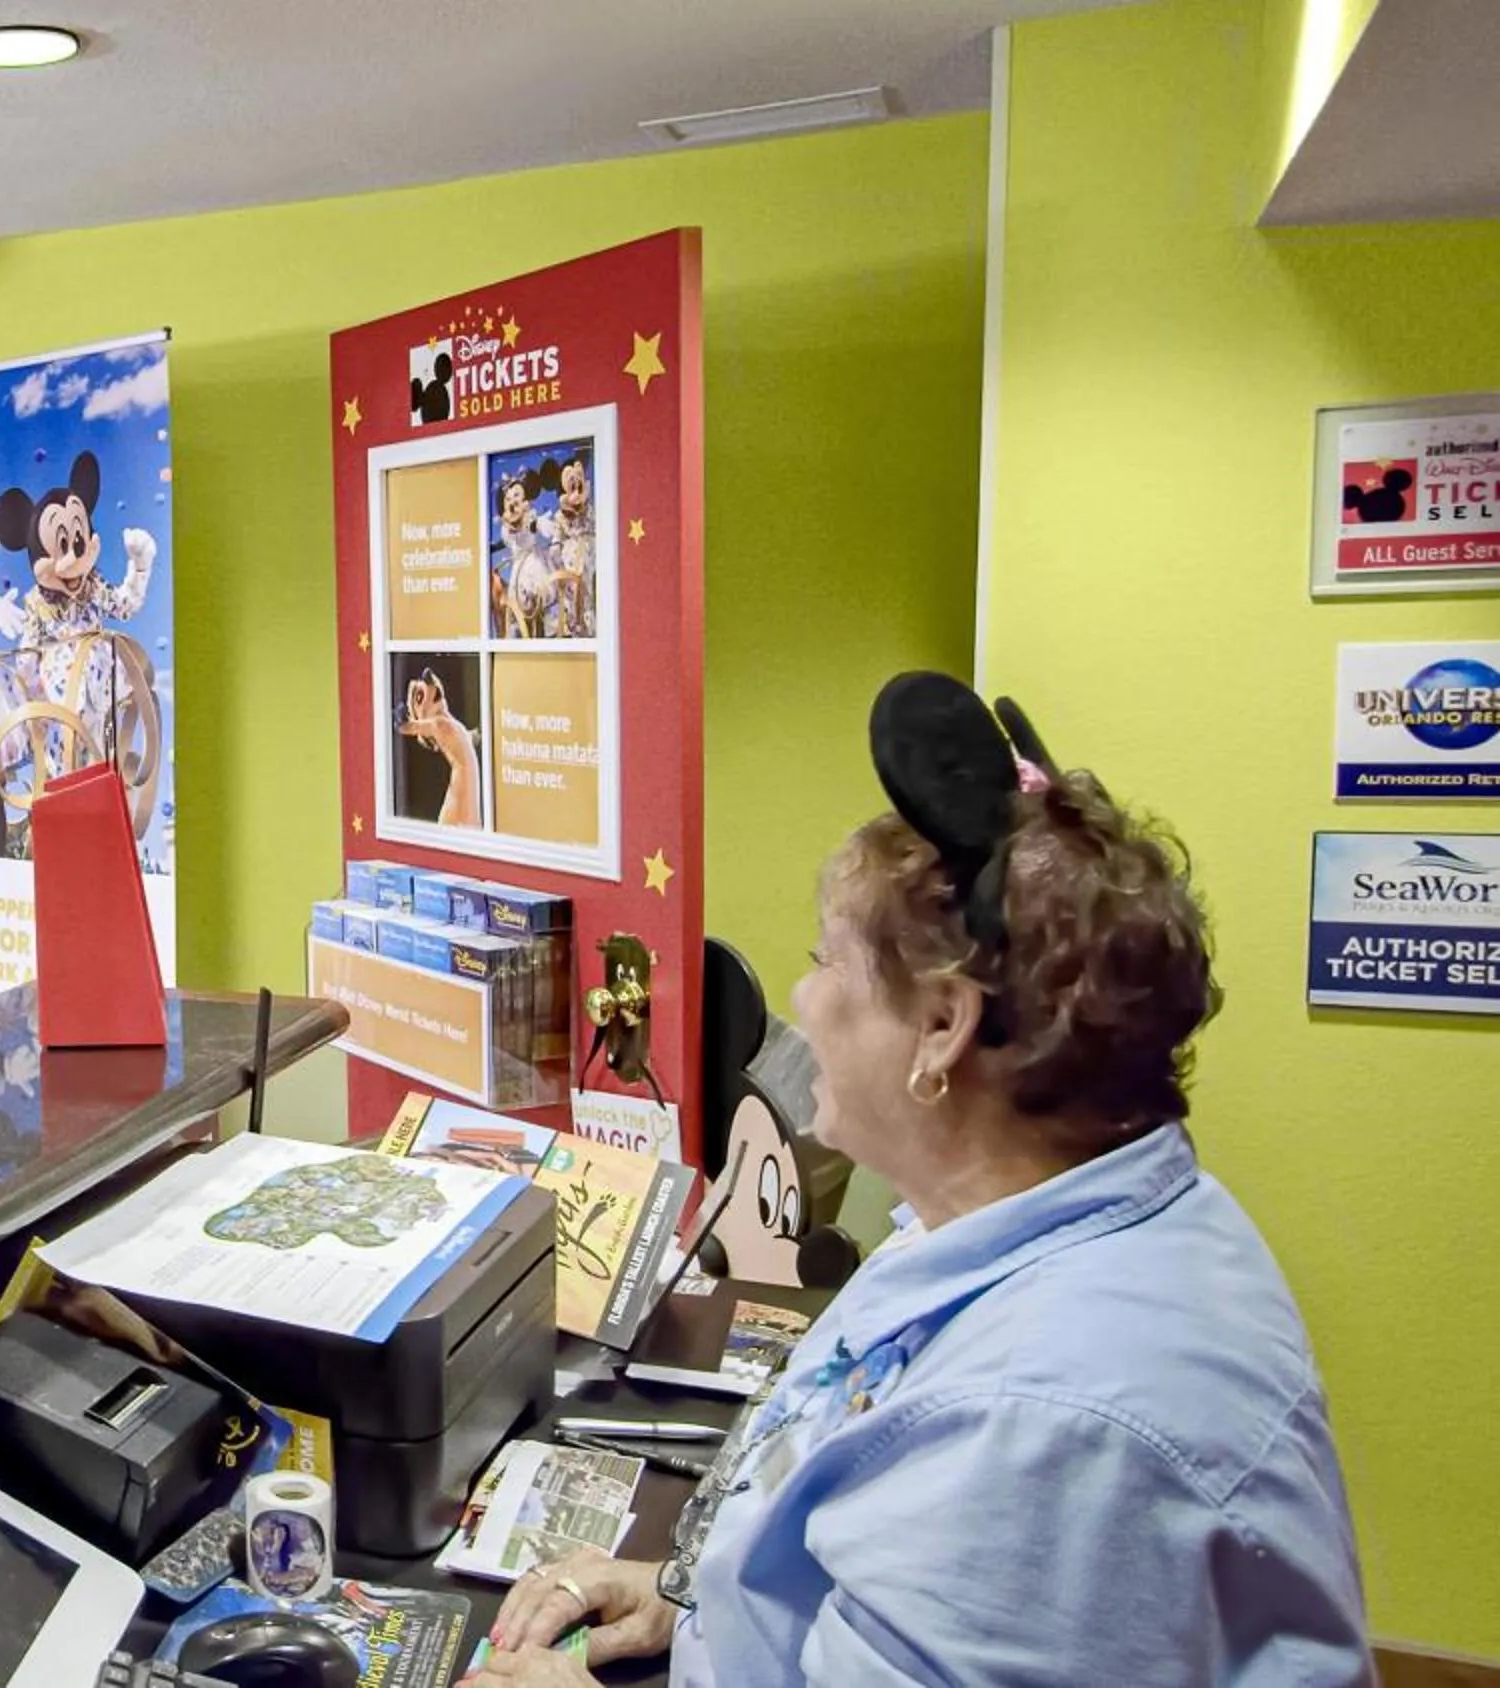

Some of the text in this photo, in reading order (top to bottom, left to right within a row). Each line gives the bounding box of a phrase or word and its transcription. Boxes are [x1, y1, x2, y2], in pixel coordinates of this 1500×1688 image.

[456, 346, 559, 397] TICKETS
[460, 381, 561, 418] SOLD HERE
[1428, 504, 1493, 520] SEL
[431, 522, 462, 540] more
[1363, 546, 1396, 564] ALL
[1403, 543, 1457, 562] Guest
[403, 576, 430, 594] than
[534, 714, 571, 733] more
[1368, 711, 1462, 727] ORLANDO
[502, 736, 550, 760] hakuna
[502, 764, 567, 789] than ever.
[1353, 872, 1498, 903] SeaWor
[1326, 958, 1500, 985] TICKET SEL
